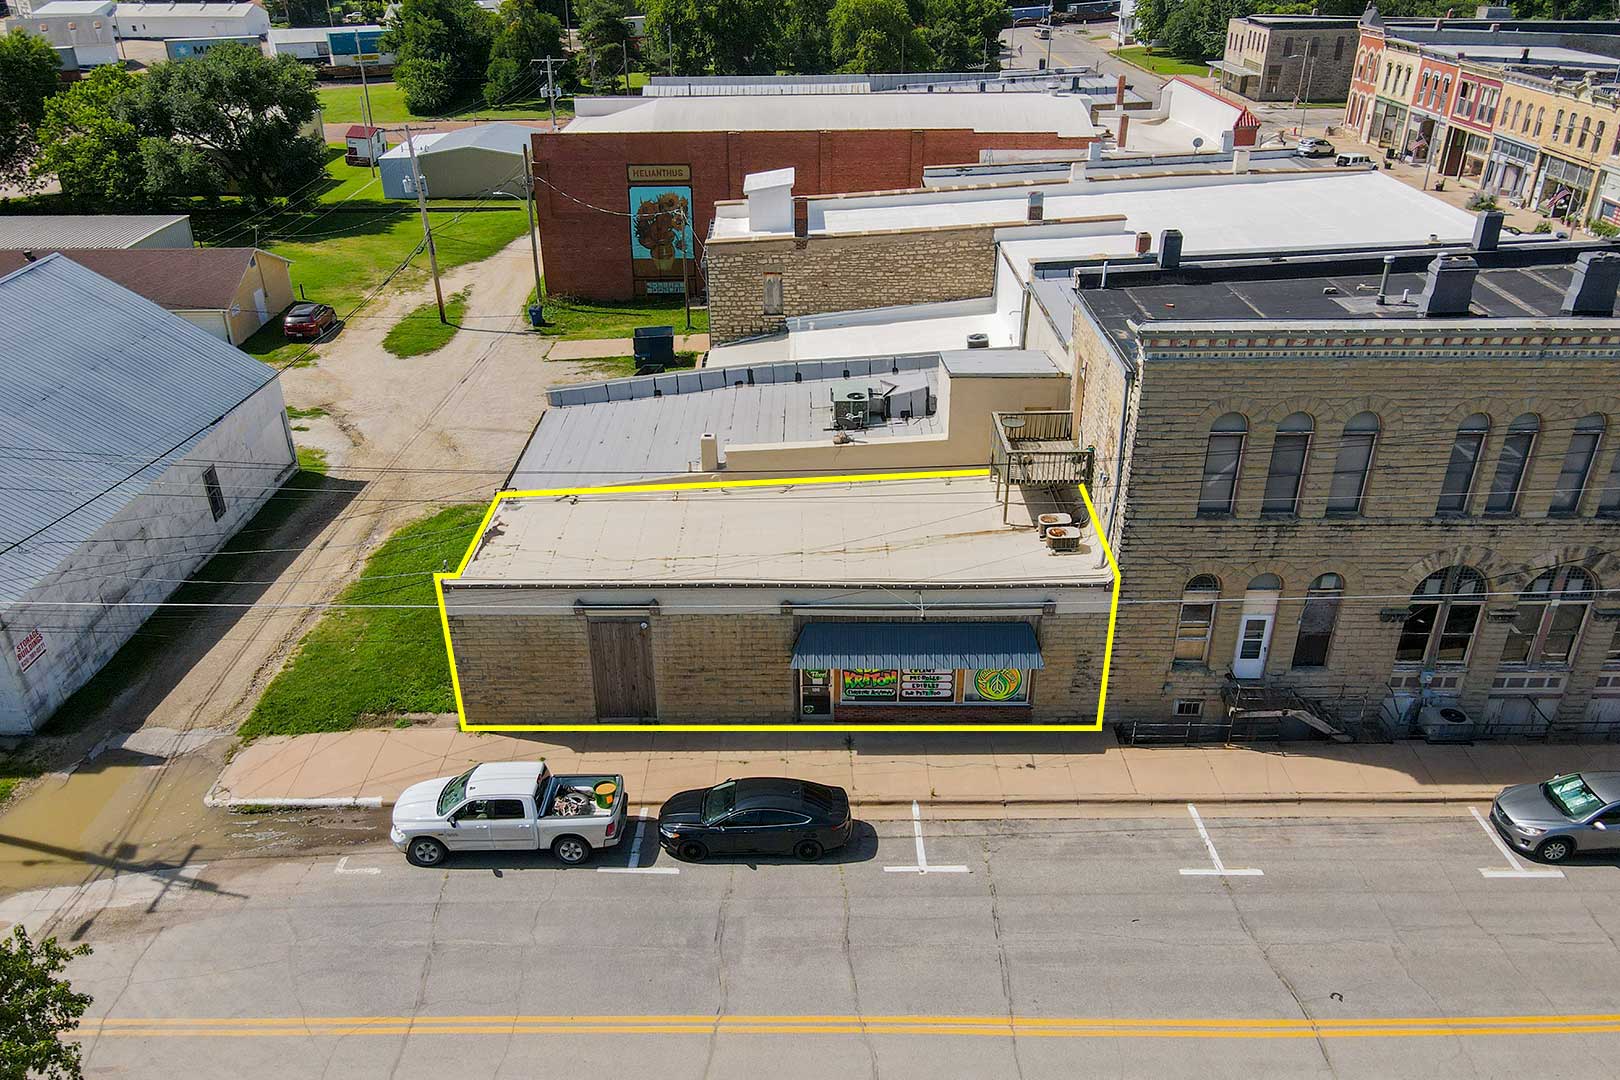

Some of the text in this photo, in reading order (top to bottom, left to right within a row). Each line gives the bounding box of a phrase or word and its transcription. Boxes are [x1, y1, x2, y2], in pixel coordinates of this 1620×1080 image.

[632, 168, 684, 177] HELIANTHUS
[16, 629, 39, 653] STORAGE
[16, 633, 44, 661] BUILDINGS
